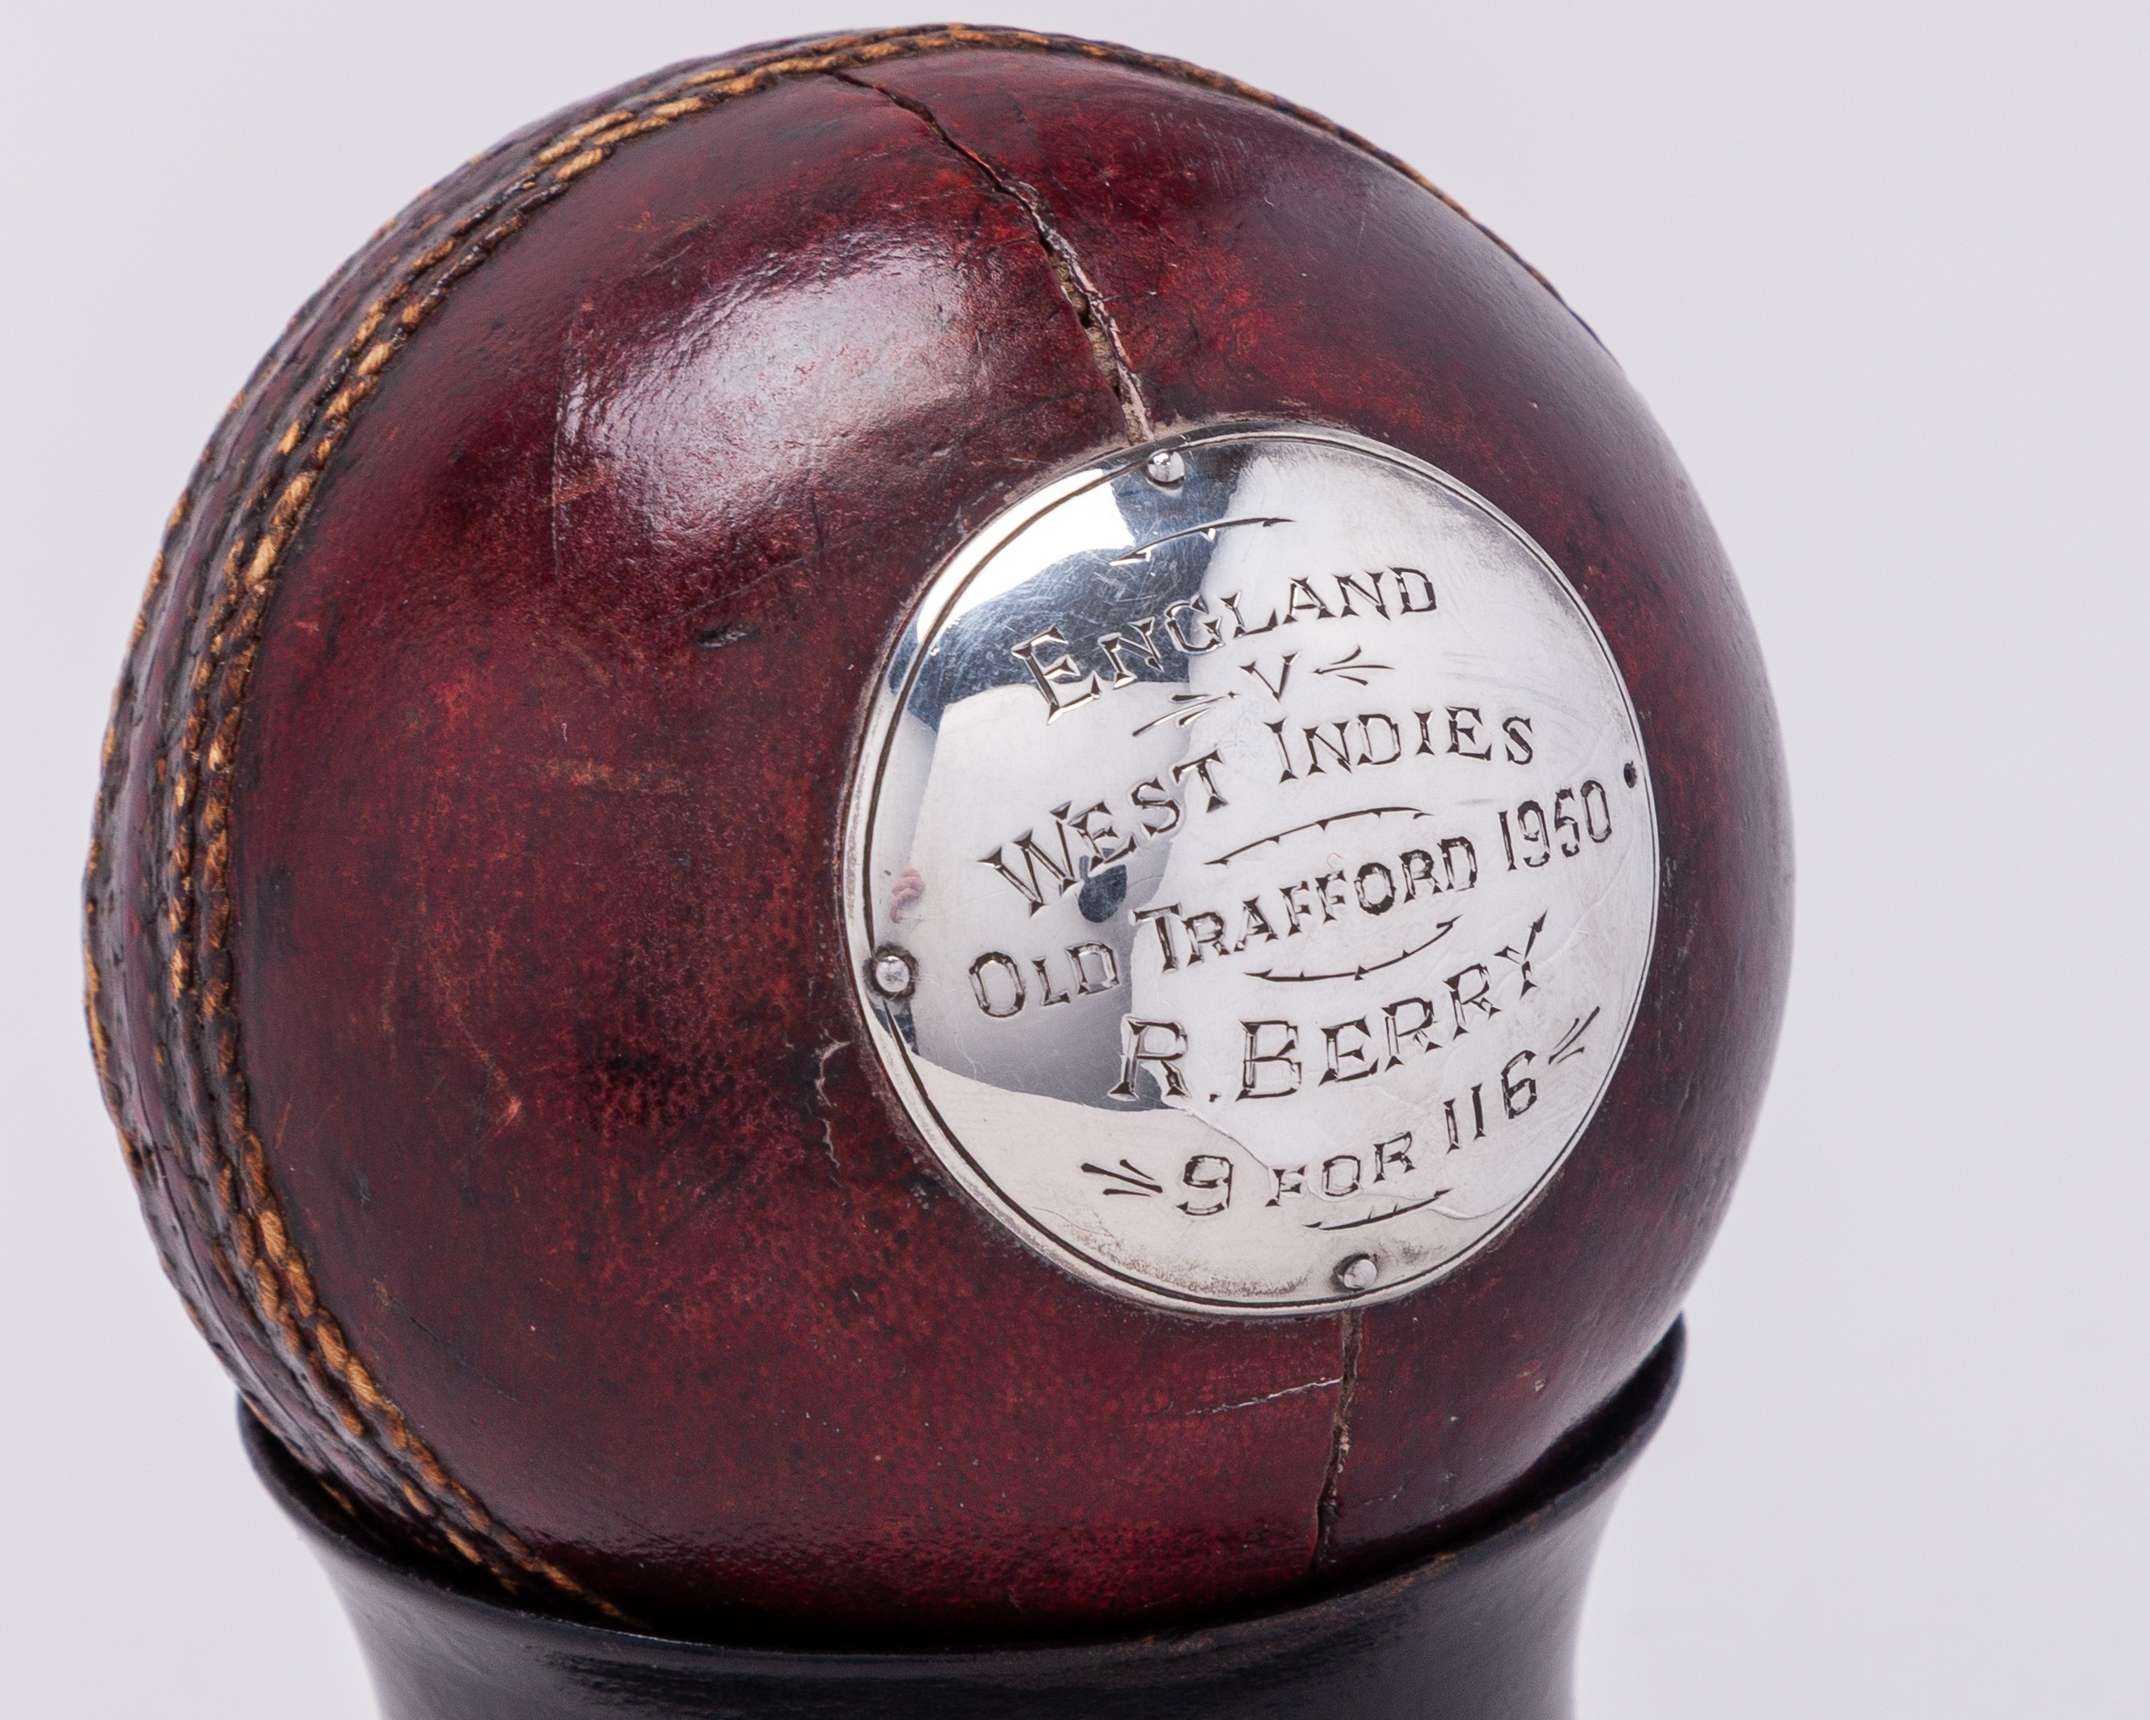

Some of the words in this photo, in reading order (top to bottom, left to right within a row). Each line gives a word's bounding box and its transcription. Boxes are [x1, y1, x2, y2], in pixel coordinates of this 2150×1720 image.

[1010, 566, 1438, 725] ENGLAND
[1240, 651, 1299, 702] V
[977, 749, 1229, 918] WEST
[1264, 705, 1535, 784] INDIES
[968, 942, 1121, 1018] OLD
[1131, 836, 1478, 974] TRAFFORD
[1497, 779, 1613, 871] 1950
[1177, 1154, 1233, 1216] 9
[1264, 1131, 1417, 1207] FOR
[1443, 1050, 1538, 1153] 116
